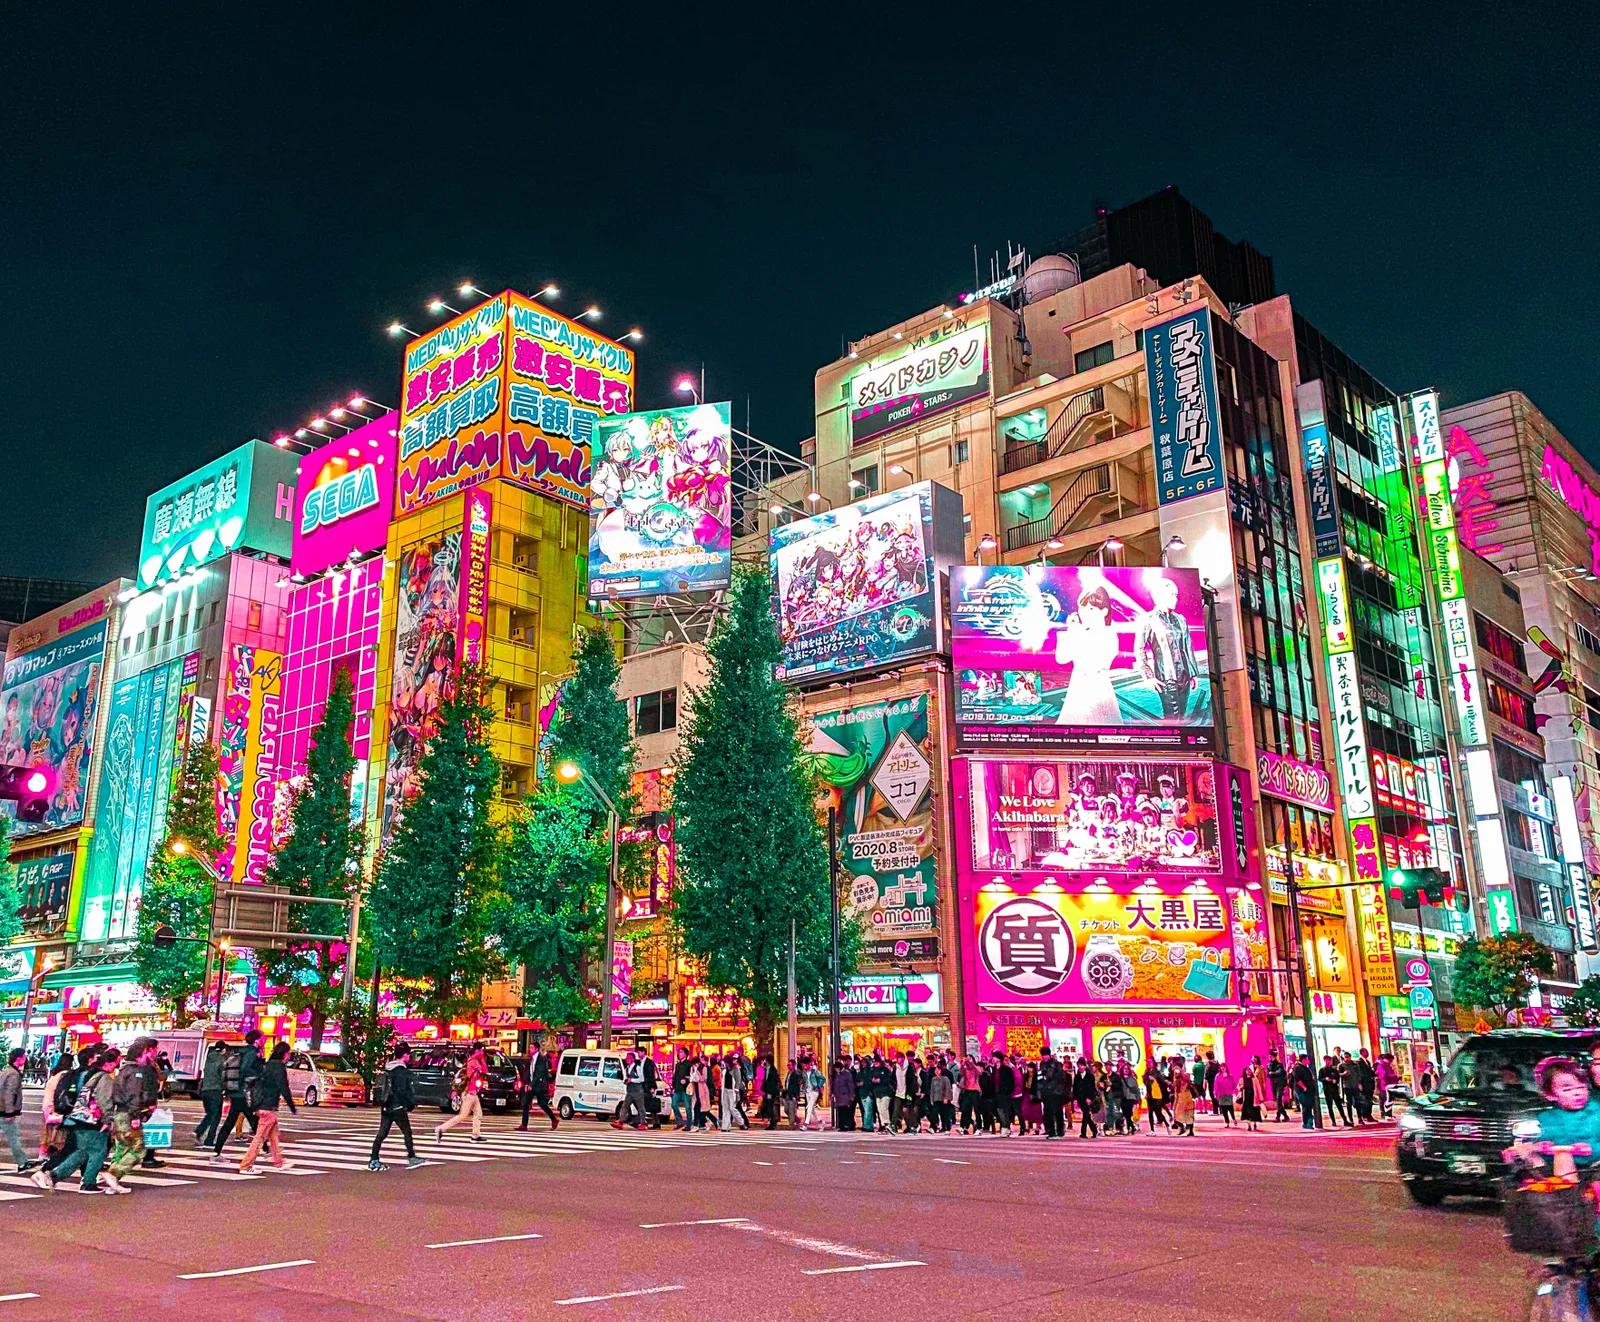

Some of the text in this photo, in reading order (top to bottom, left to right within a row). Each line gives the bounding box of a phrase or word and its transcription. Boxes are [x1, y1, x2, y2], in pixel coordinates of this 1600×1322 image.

[408, 297, 506, 374] MEDIAリサイクル
[511, 305, 632, 375] MEDIAリサイクル
[406, 333, 503, 415] 激安販売
[512, 335, 631, 416] 激安販売
[857, 340, 979, 406] メイドカジノ
[888, 405, 911, 422] POKER
[1167, 318, 1215, 478] アメニティドリーム
[402, 376, 499, 461] 高額買取
[399, 430, 500, 511] Mulan
[1159, 432, 1174, 483] 秋葉原店
[301, 463, 379, 535] SEGA
[436, 484, 458, 499] AKIBA
[519, 471, 586, 503] ムーラン AKIBA
[1429, 490, 1443, 526] Yellow
[1436, 535, 1453, 593] Submarine
[1329, 582, 1341, 625] りらくる
[890, 780, 917, 798] ココ
[1258, 756, 1330, 803] メイドカジノ
[992, 811, 1066, 823] Akihabara
[999, 795, 1056, 808] We Love
[854, 841, 898, 858] 2020.8
[873, 855, 919, 870] 予約受付中
[872, 907, 932, 925] amiami
[1080, 919, 1120, 931] チケット
[1126, 899, 1224, 932] 大黒屋
[991, 913, 1070, 983] 質
[1376, 921, 1391, 963] FREE
[1412, 964, 1425, 975] 40
[839, 986, 878, 1003] OMIC
[480, 1011, 513, 1025] ラーメン
